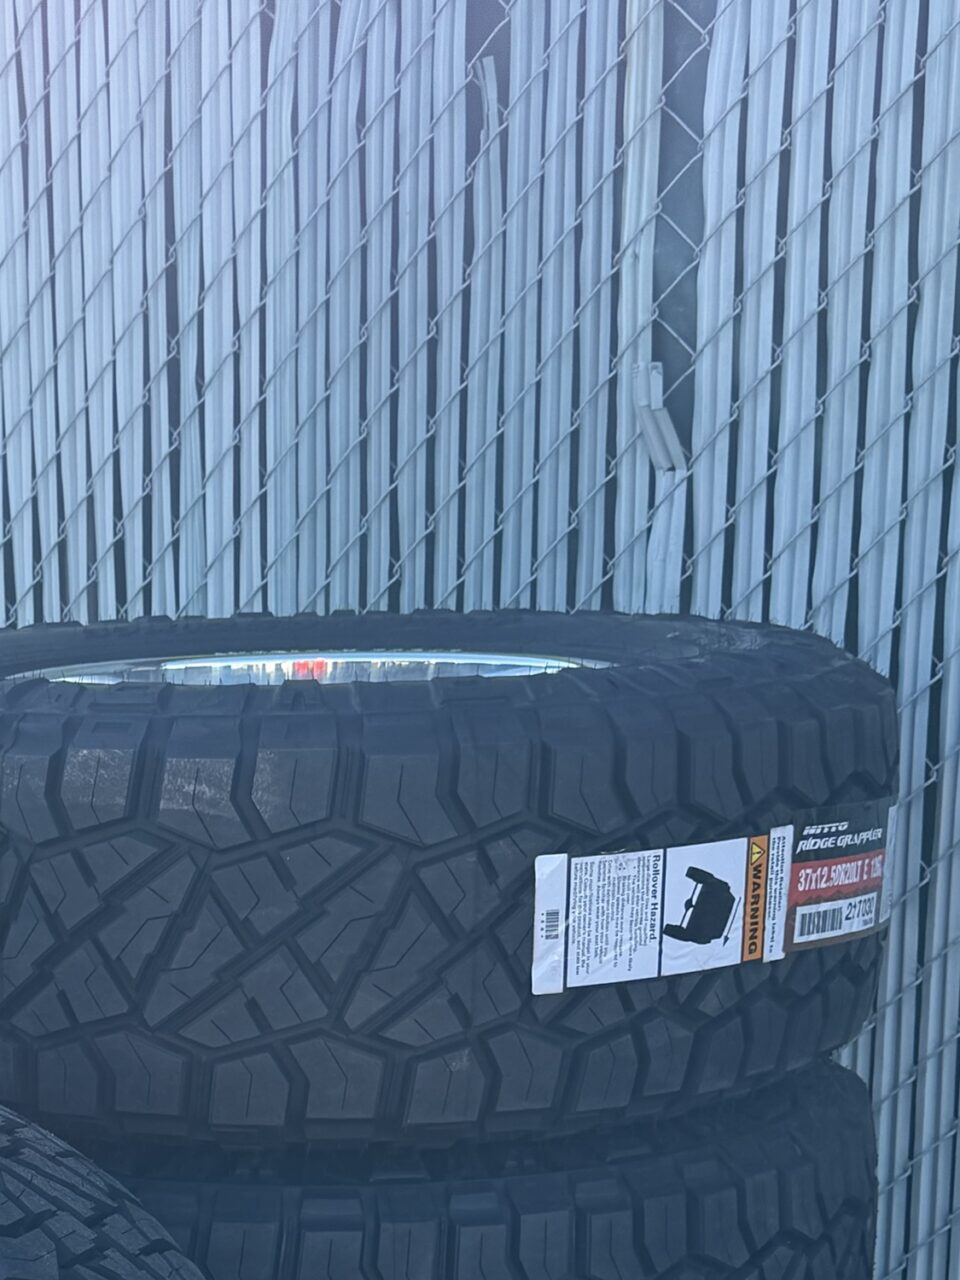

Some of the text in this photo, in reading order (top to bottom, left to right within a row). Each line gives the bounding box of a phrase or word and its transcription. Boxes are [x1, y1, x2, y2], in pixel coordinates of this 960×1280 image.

[796, 828, 883, 854] RIDGE GRAPPLER
[803, 821, 848, 836] NITTO
[649, 854, 661, 943] Rollover Hazard.
[749, 864, 762, 954] WARNING
